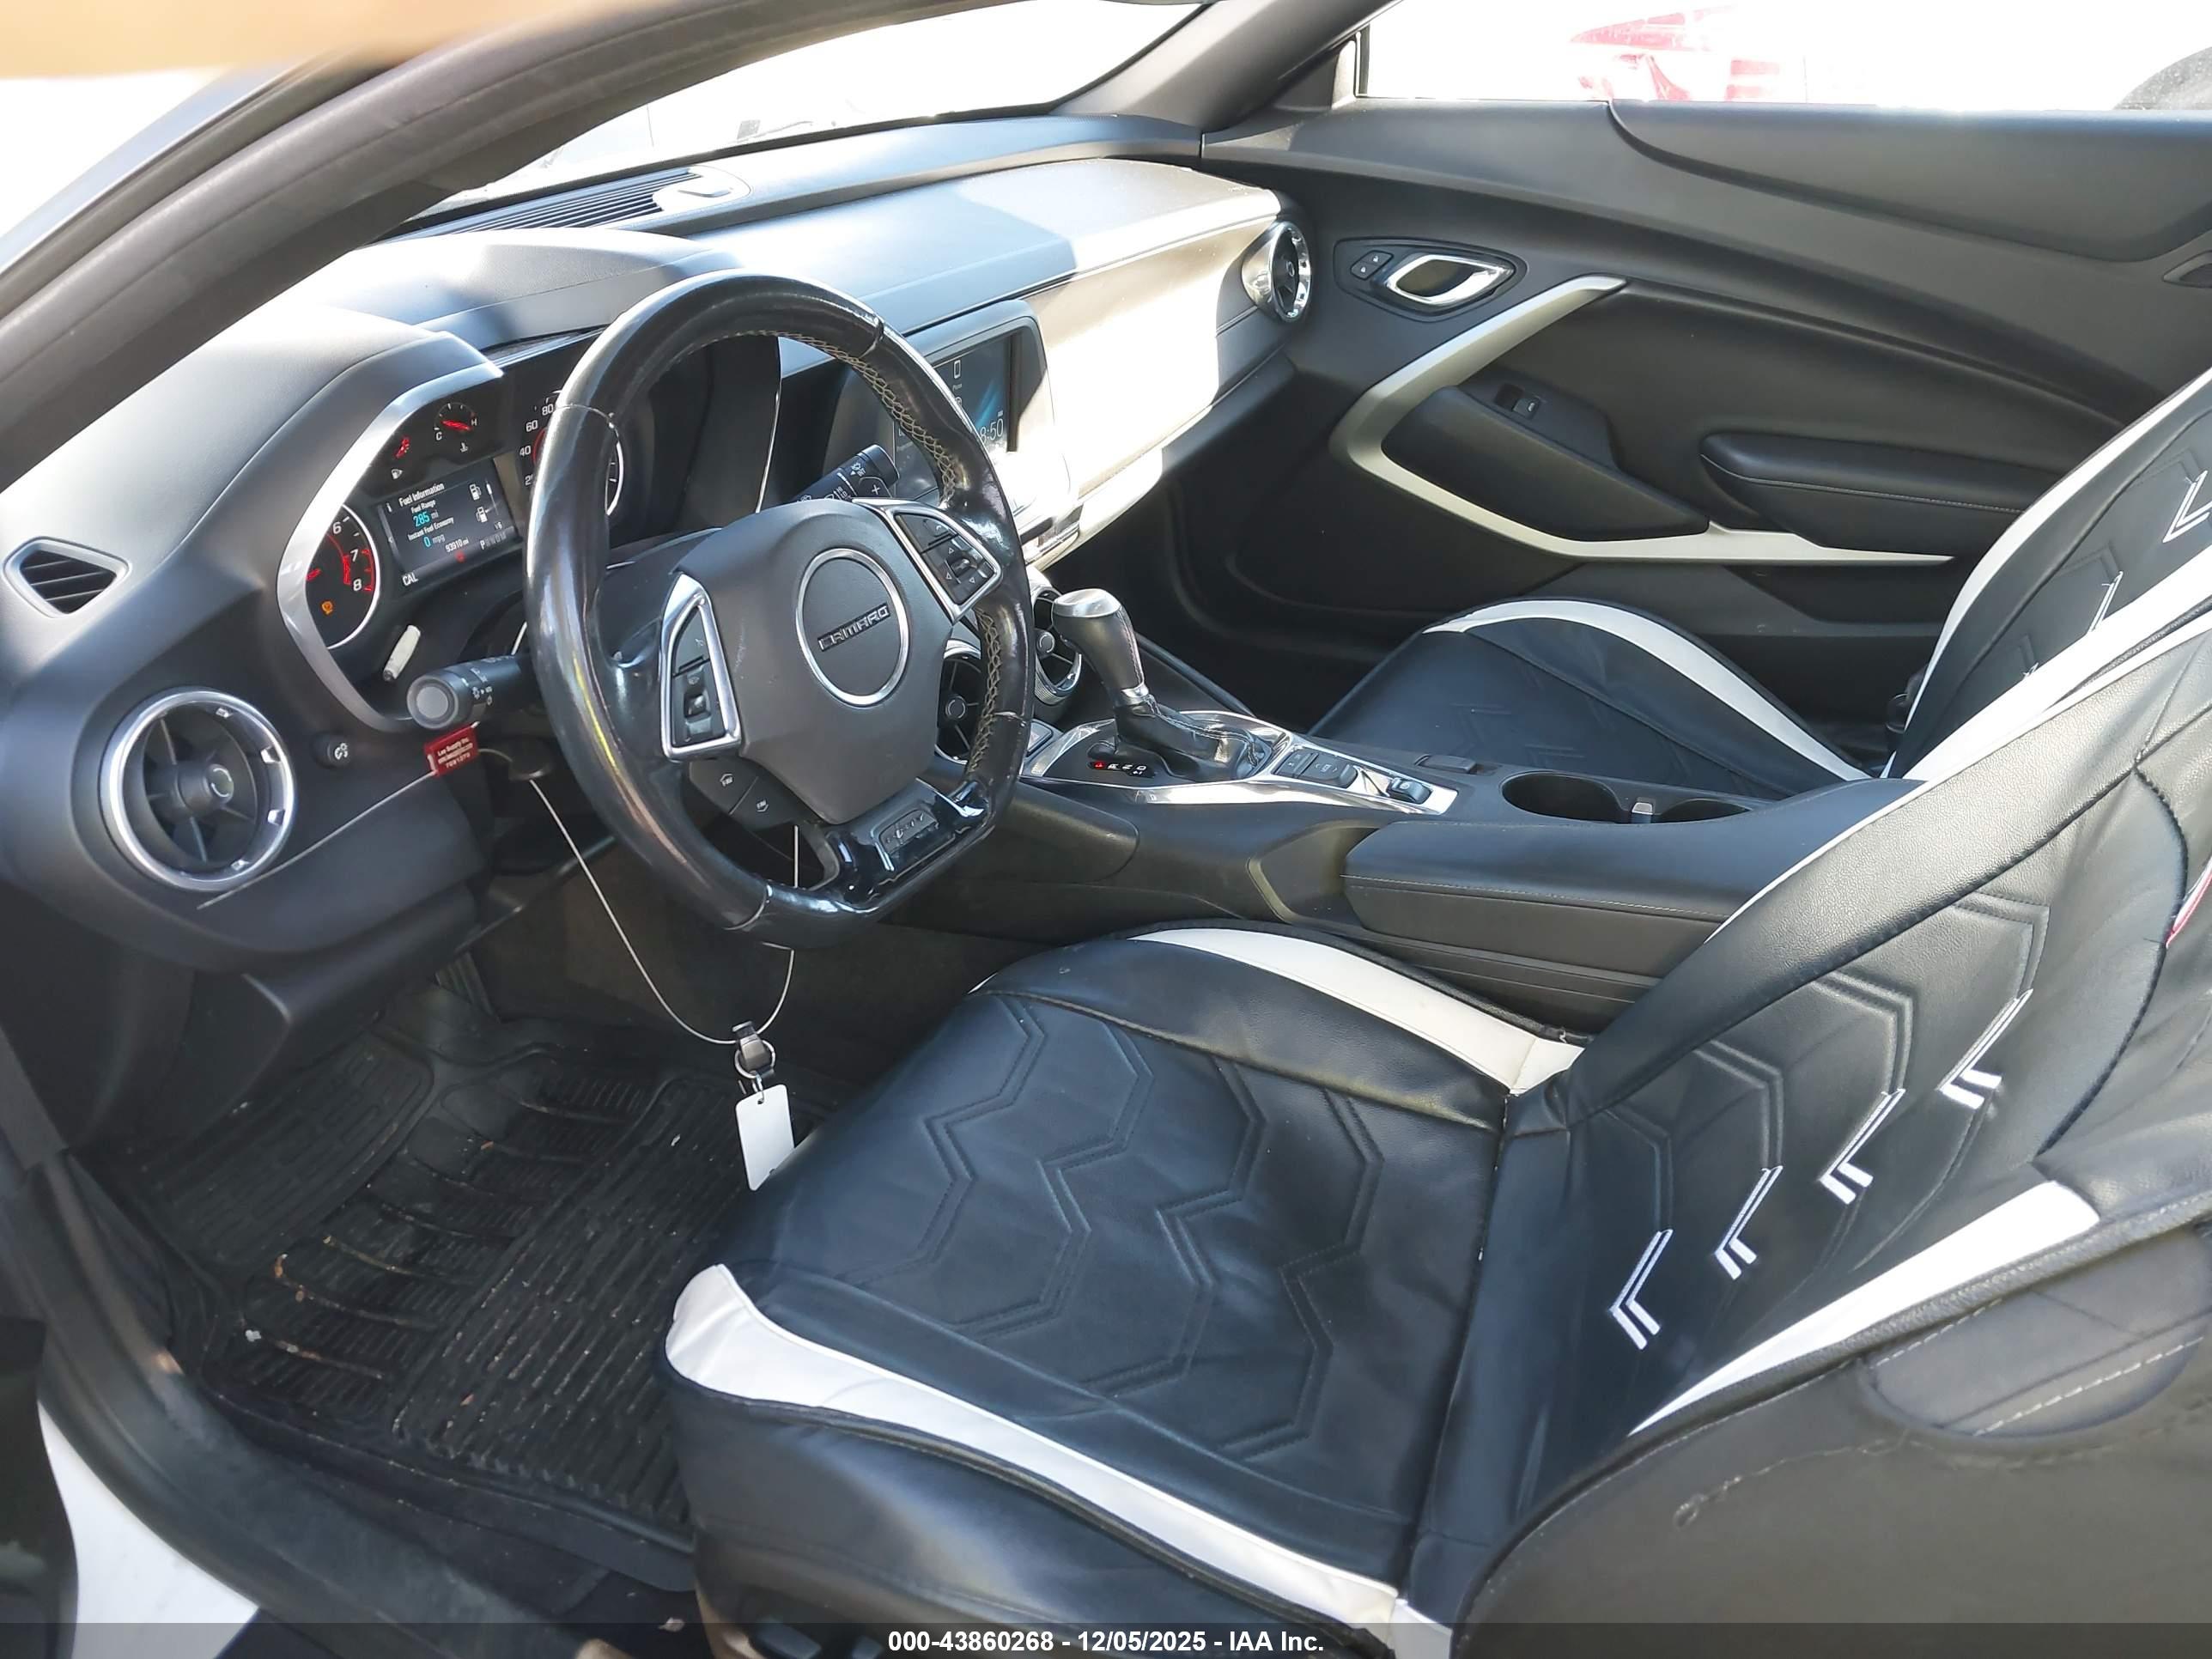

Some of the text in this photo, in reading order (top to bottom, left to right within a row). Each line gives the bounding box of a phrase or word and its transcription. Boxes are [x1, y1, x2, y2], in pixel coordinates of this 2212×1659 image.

[542, 404, 554, 416] 80
[526, 420, 538, 432] 60
[435, 431, 443, 441] C
[519, 446, 532, 457] 40
[525, 473, 534, 486] 2
[398, 483, 446, 507] Fuel Information
[421, 499, 437, 511] Range
[412, 511, 430, 527] 285
[434, 516, 455, 530] Economy
[332, 521, 342, 534] 6
[423, 534, 431, 549] 0
[350, 548, 359, 562] 7
[353, 578, 362, 592] 8
[402, 572, 419, 586] CAL
[817, 604, 890, 651] CAMARO
